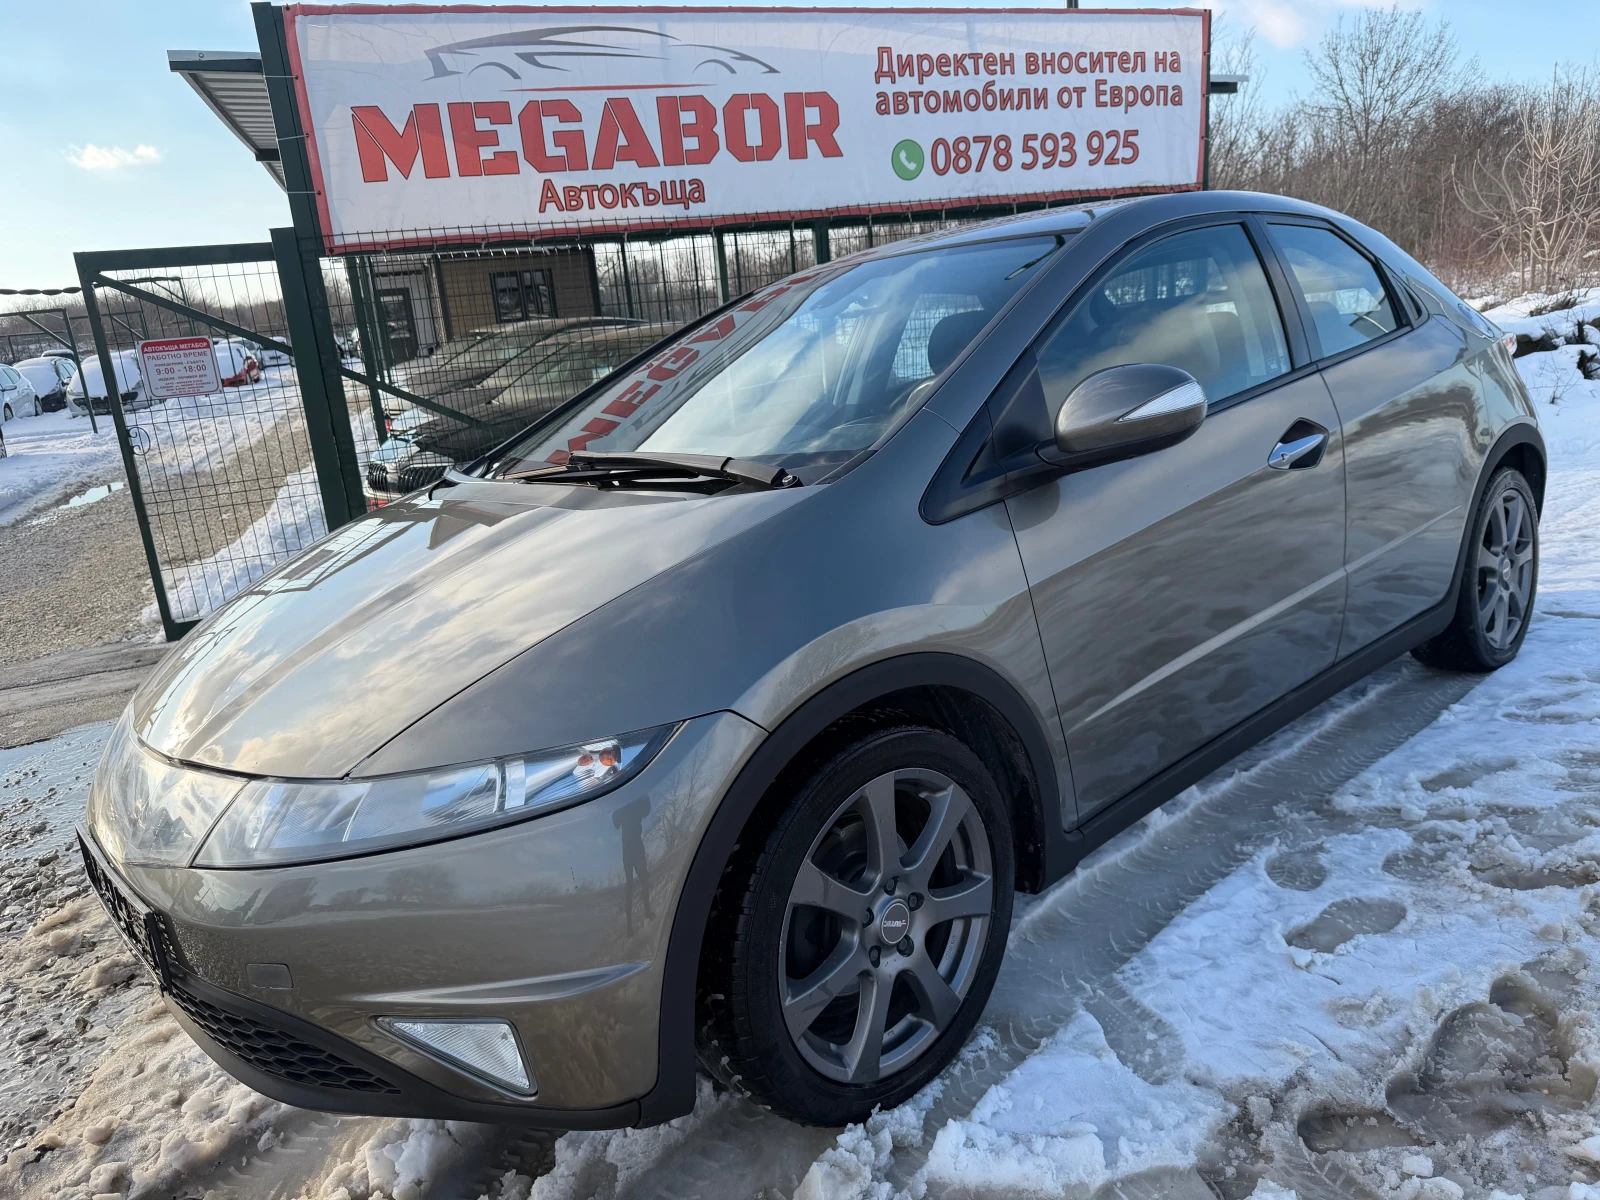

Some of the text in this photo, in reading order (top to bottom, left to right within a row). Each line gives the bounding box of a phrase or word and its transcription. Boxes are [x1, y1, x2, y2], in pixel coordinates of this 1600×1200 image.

[874, 46, 1181, 84] Директен вносител на
[875, 79, 1183, 115] автомобили от Европа
[350, 91, 843, 183] MEGABOR
[930, 129, 1139, 176] 0878 593 925
[538, 175, 706, 213] Автокъща
[143, 342, 208, 353] АВТОКЪЩА МЕГАБОР
[147, 353, 182, 361] РАБОТНО
[155, 367, 175, 375] 9:00
[183, 364, 207, 373] 18:00
